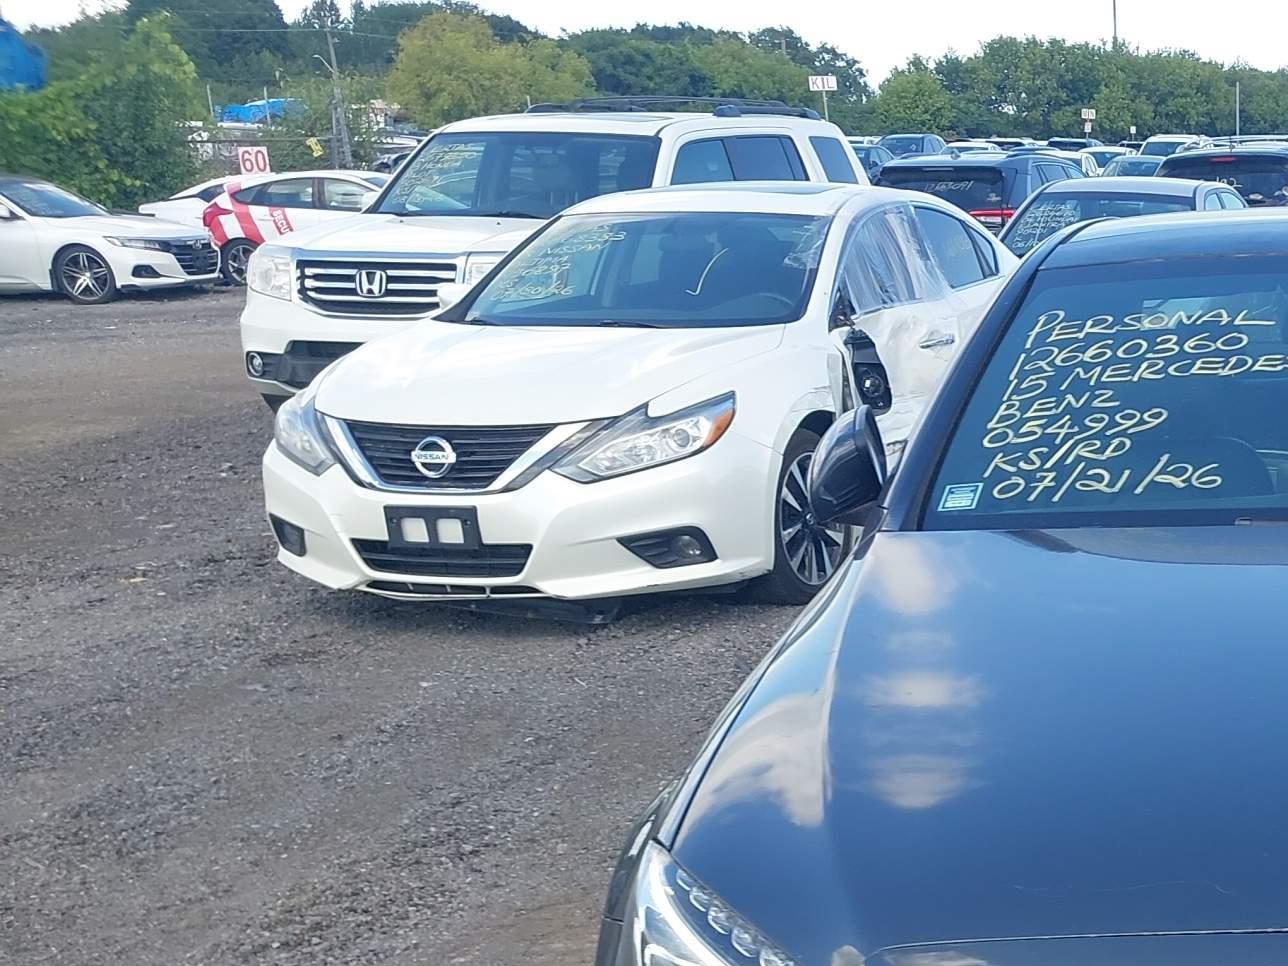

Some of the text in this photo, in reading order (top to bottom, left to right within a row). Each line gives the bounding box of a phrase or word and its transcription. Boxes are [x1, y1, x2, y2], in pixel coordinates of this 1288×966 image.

[241, 150, 267, 172] 60
[1025, 309, 1277, 348] PERSONAL
[1009, 332, 1250, 380] 12660360
[1002, 372, 1055, 401] 15
[982, 406, 1169, 448] 054999
[987, 389, 1121, 429] BENZ
[992, 453, 1223, 502] 07/21/26
